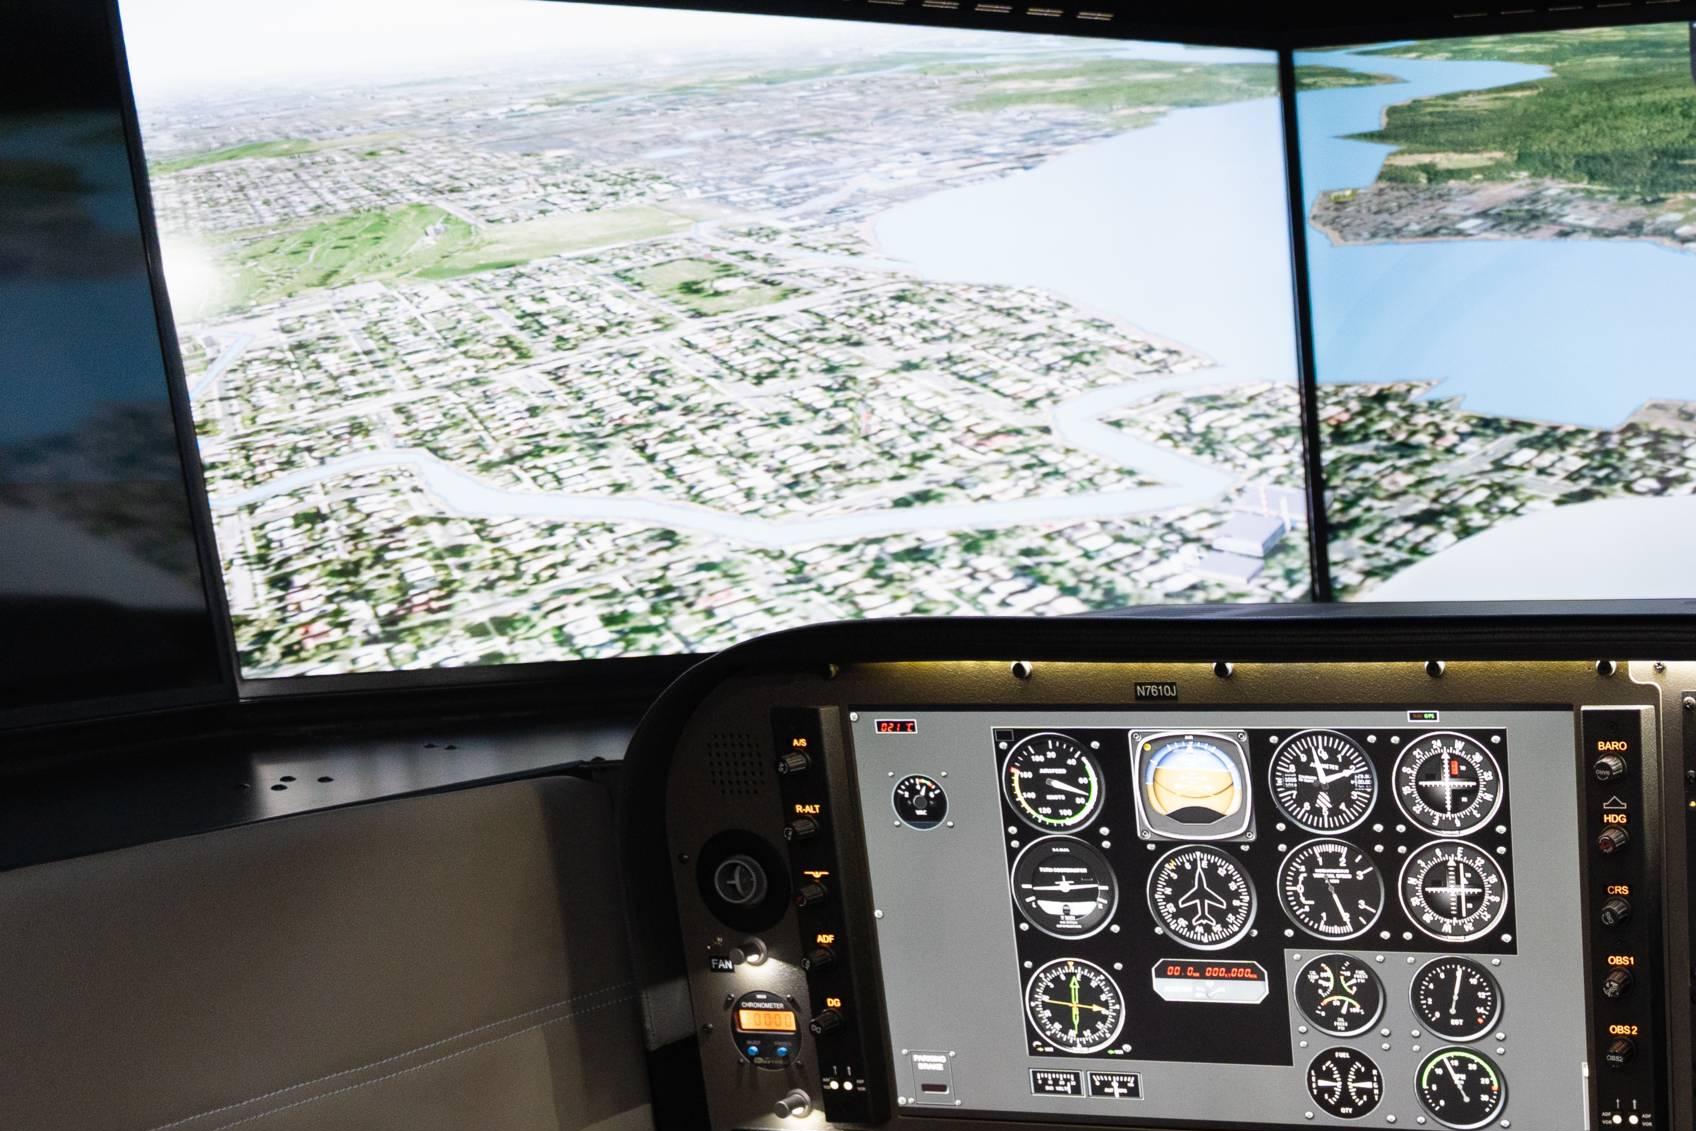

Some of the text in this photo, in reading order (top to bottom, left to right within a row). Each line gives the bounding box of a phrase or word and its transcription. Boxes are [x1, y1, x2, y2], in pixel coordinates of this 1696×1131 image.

[1136, 685, 1177, 697] N7610J
[792, 738, 807, 747] A/S
[1598, 741, 1627, 751] BARO
[795, 804, 820, 814] R-ALT
[1603, 814, 1627, 824] HDG
[1607, 885, 1629, 895] CRS
[816, 934, 835, 944] ADF
[711, 959, 733, 970] FAN
[1607, 956, 1634, 966] OBS1
[741, 1001, 785, 1010] CHRONOMETER
[826, 998, 841, 1008] DG
